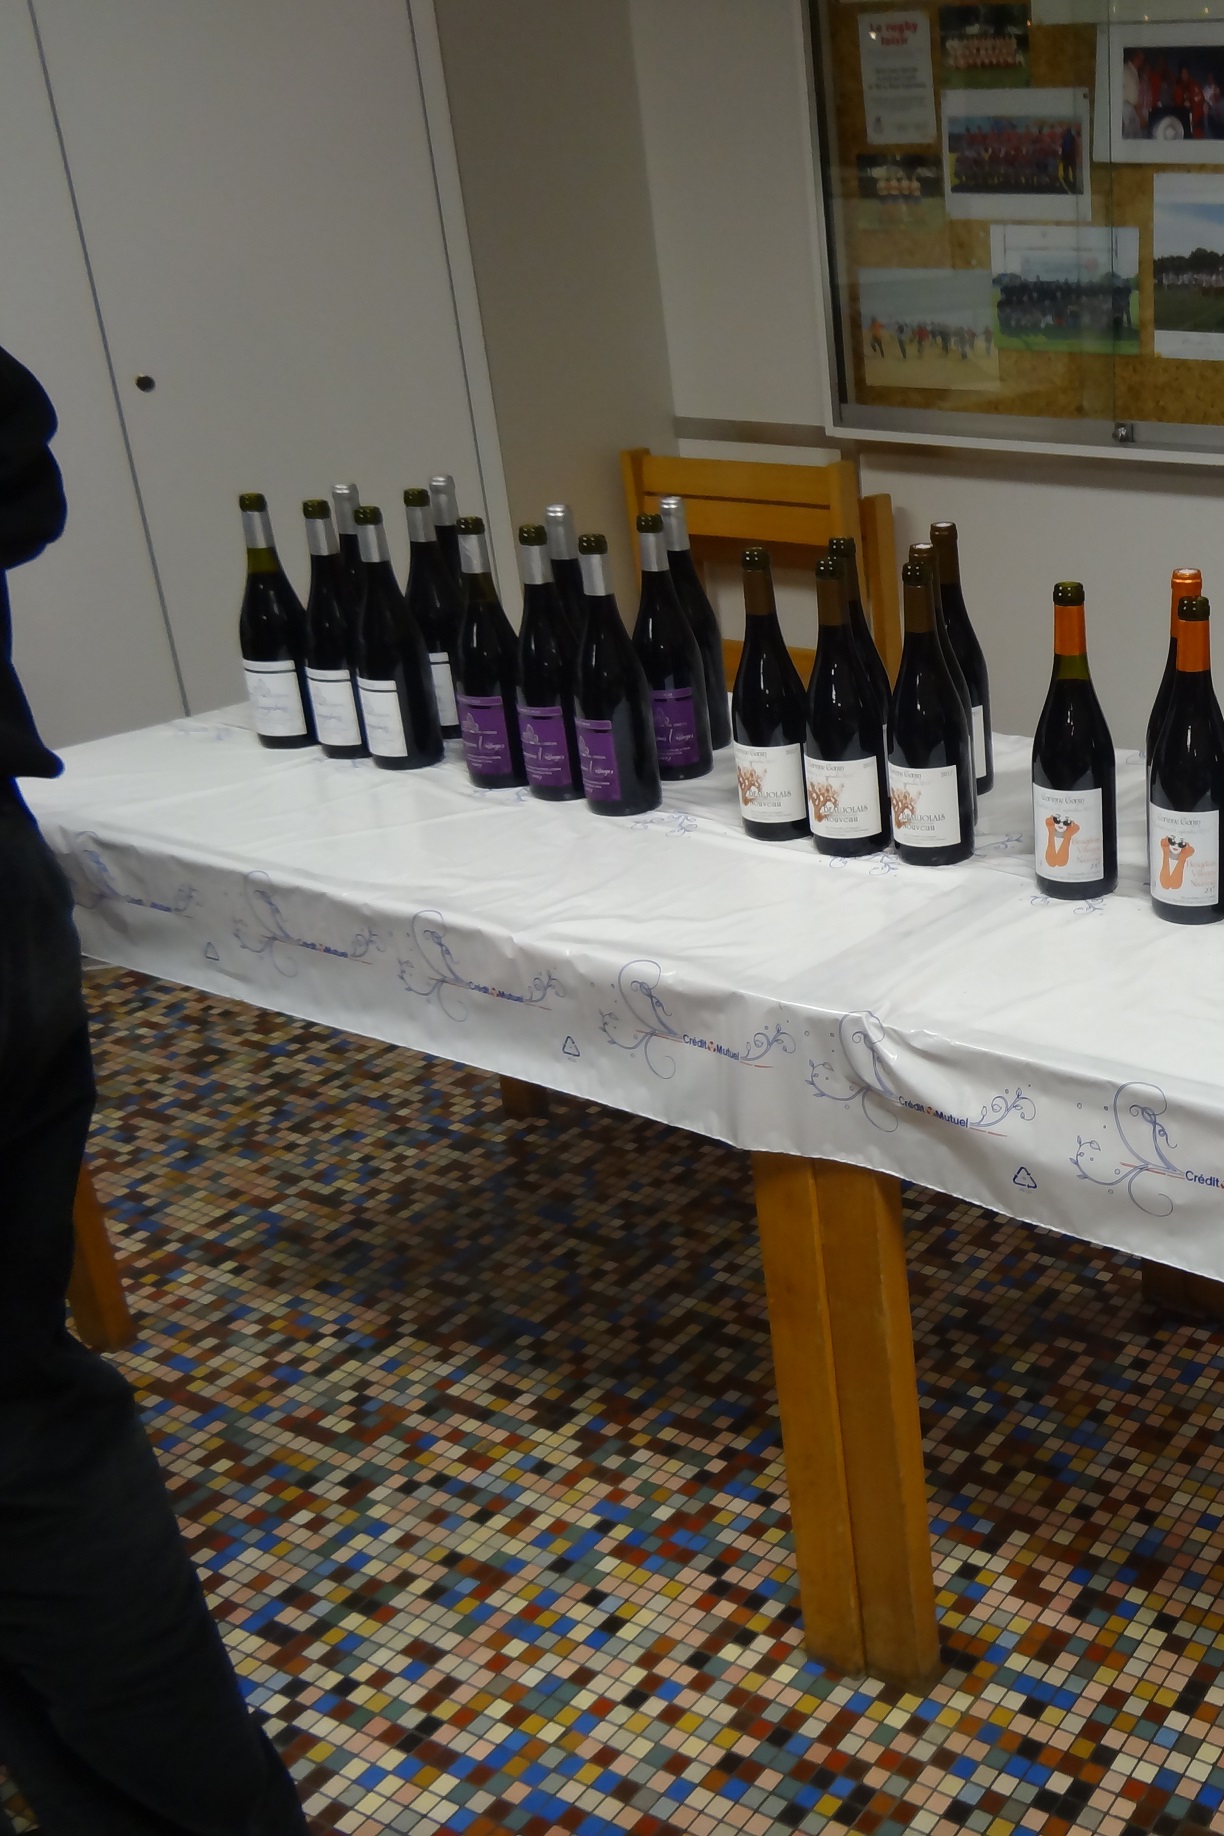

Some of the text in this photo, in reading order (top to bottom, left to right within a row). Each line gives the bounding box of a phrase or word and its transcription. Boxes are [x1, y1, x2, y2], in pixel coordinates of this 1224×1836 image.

[823, 805, 868, 814] BEAUJOLAIS
[902, 812, 946, 822] BEAUJOLAIS
[683, 1034, 740, 1061] Crédit Mutuel
[899, 1095, 969, 1128] Crédit Mutuel
[1185, 1170, 1220, 1188] Crédit
